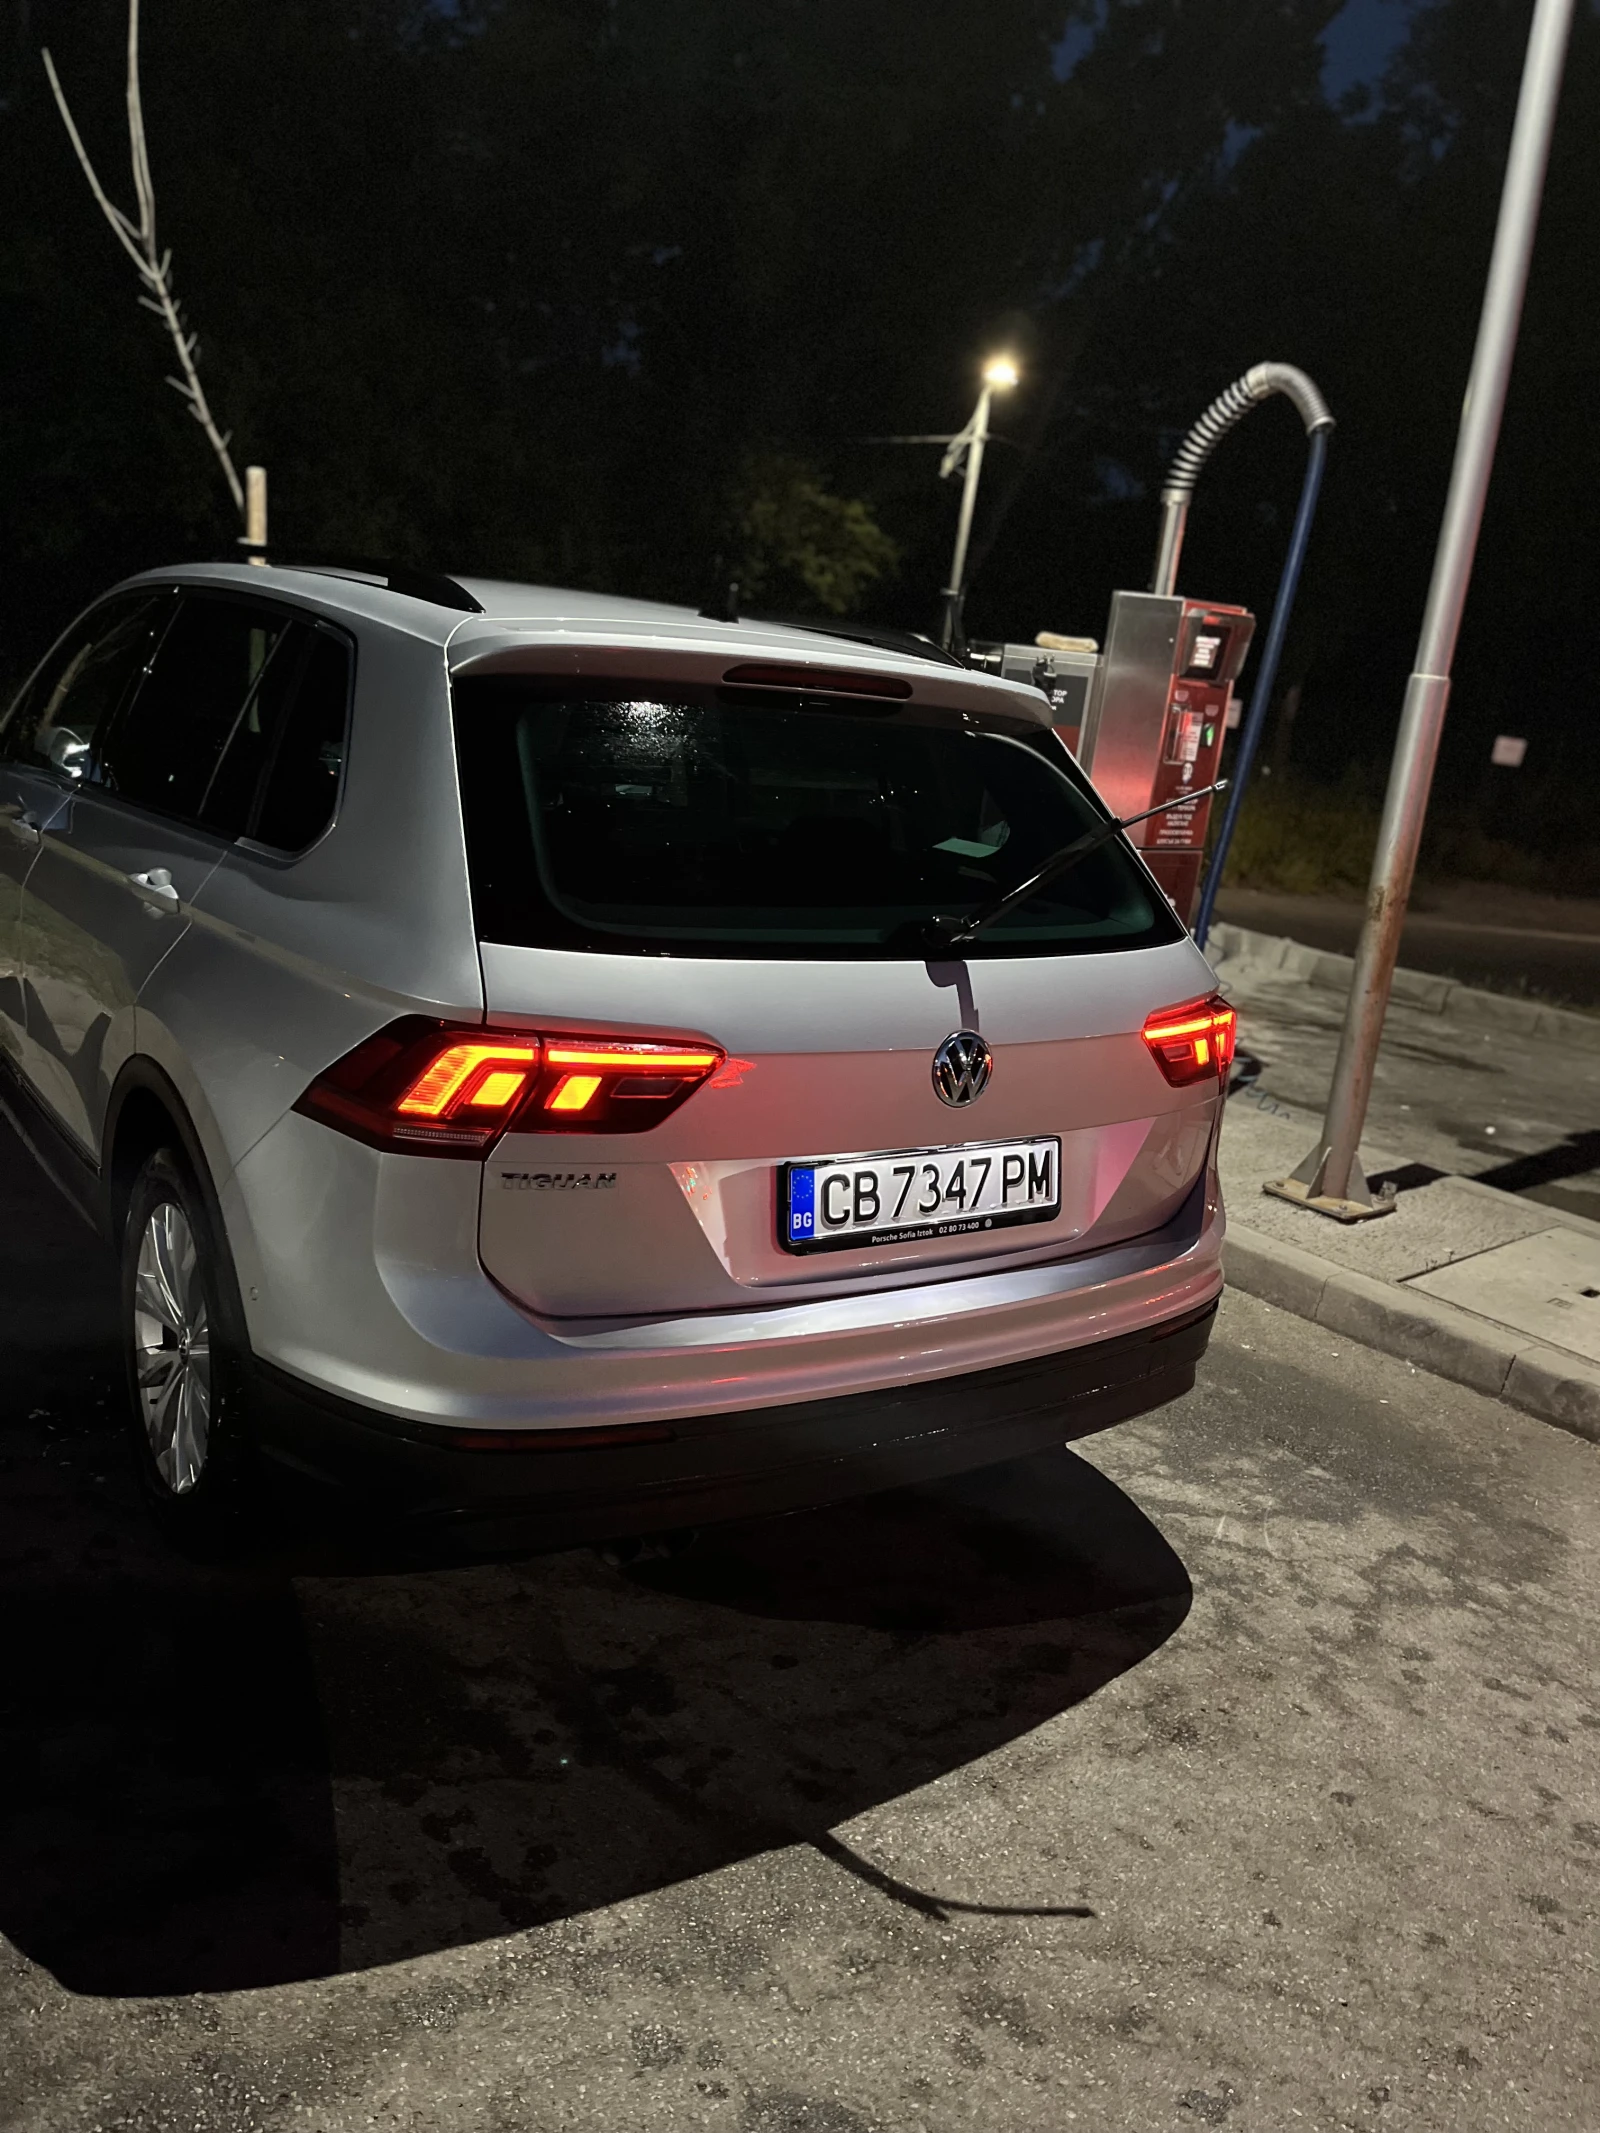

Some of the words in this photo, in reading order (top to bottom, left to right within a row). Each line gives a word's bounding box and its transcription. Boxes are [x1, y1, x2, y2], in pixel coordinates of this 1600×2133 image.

[934, 1032, 991, 1106] VW
[501, 1172, 617, 1191] TIGUAN
[822, 1170, 881, 1226] CB
[893, 1156, 992, 1219] 7347
[1002, 1149, 1051, 1204] PM
[793, 1211, 812, 1230] BG
[871, 1232, 898, 1244] Porsche
[899, 1229, 916, 1240] Sofia
[917, 1228, 934, 1237] Iztok
[938, 1226, 948, 1234] 02
[948, 1224, 957, 1233] 80
[958, 1223, 966, 1232] 73
[967, 1221, 980, 1230] 400
